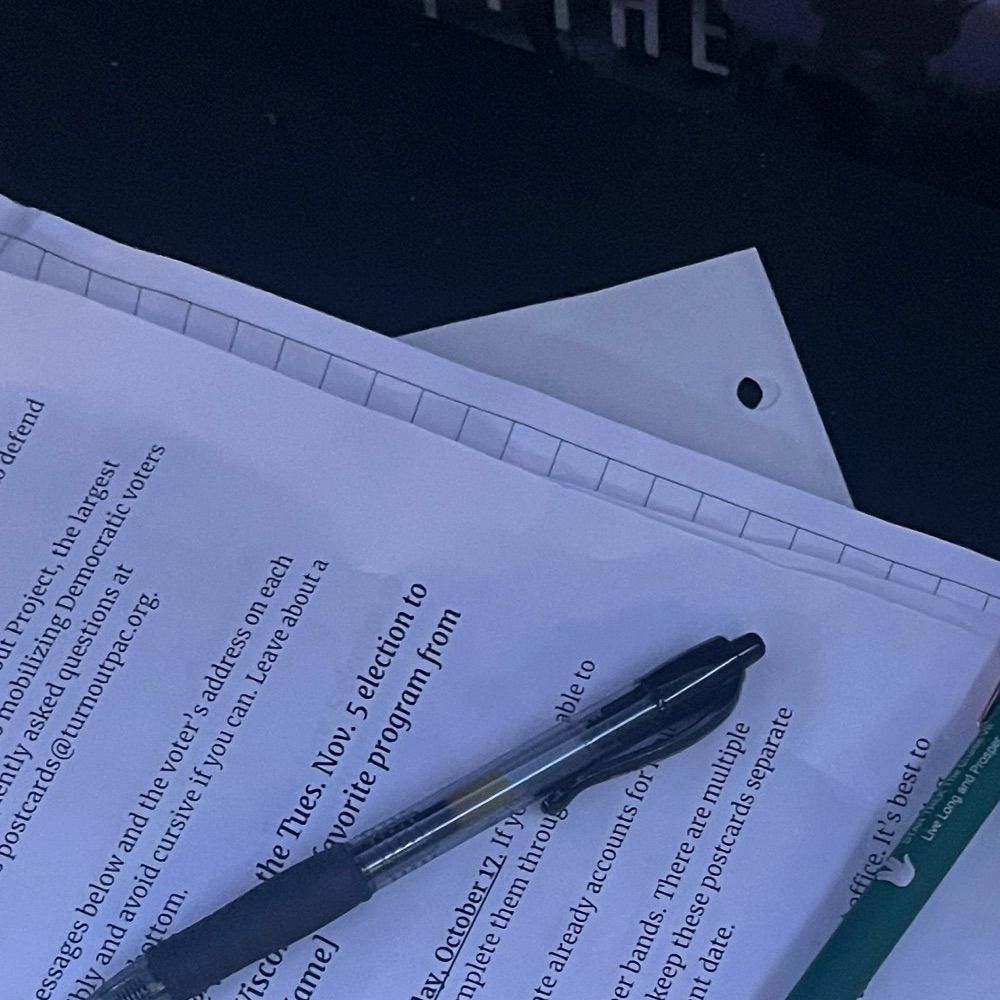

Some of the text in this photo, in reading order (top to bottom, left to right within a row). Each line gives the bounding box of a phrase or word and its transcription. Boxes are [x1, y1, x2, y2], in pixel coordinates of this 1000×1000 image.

[0, 397, 46, 466] defend
[3, 459, 120, 636] Project, the largest
[0, 613, 72, 721] mobilizing
[54, 503, 131, 612] Democratic
[122, 444, 166, 499] voters
[401, 583, 428, 608] to
[23, 563, 134, 742] asked questions at
[356, 611, 415, 700] election
[573, 660, 596, 680] to
[345, 701, 368, 721] 5
[367, 668, 431, 772] program
[416, 608, 462, 668] from
[0, 592, 160, 861] postcards@turnoutpac.org.
[74, 853, 125, 918] below
[117, 811, 150, 853] and
[137, 777, 169, 811] the
[159, 704, 209, 772] voter's
[201, 627, 252, 703] address
[244, 601, 268, 626] on
[260, 555, 294, 598] each
[310, 726, 357, 777] Nov.
[909, 738, 931, 759] to
[275, 783, 327, 840] Tues.
[886, 762, 921, 808] best
[921, 820, 942, 841] Live
[937, 795, 963, 820] Long
[958, 774, 976, 795] and
[490, 827, 514, 849] If
[618, 908, 667, 974] bands.
[653, 842, 696, 901] There
[686, 806, 712, 839] are
[702, 722, 751, 806] multiple
[872, 811, 902, 846] It's
[255, 844, 290, 880] the
[478, 854, 508, 883] 17.
[434, 880, 492, 967] October
